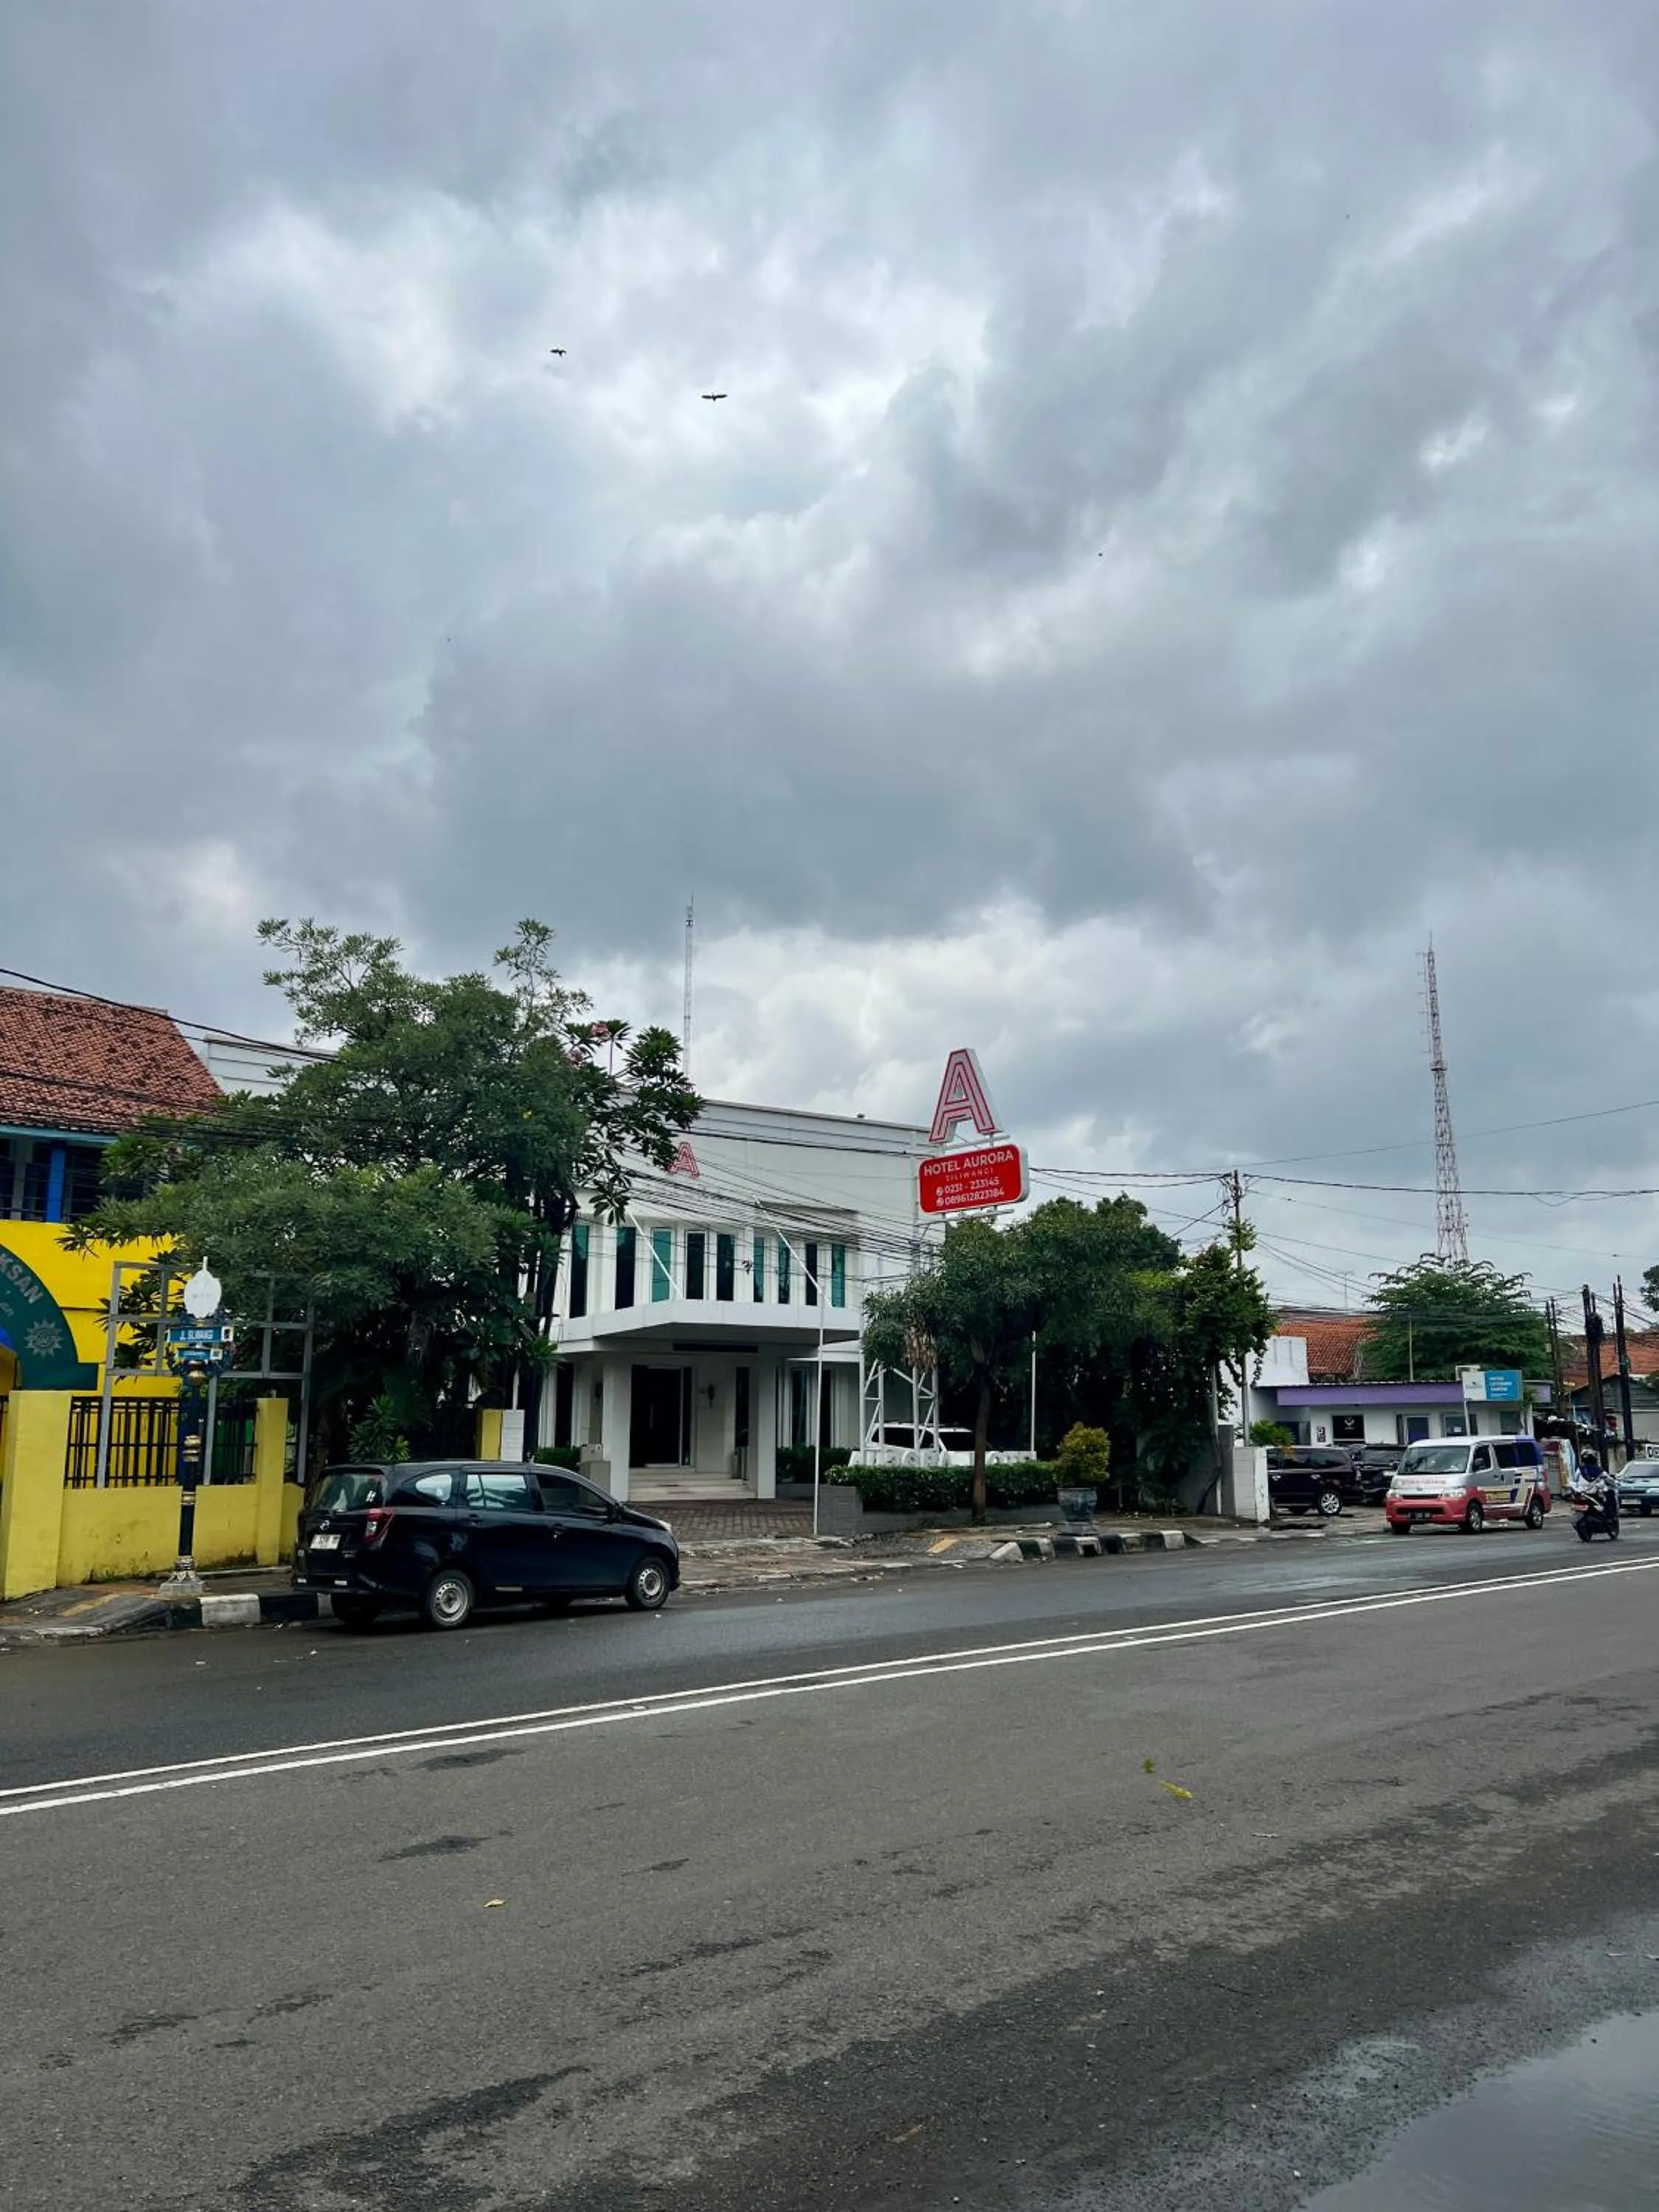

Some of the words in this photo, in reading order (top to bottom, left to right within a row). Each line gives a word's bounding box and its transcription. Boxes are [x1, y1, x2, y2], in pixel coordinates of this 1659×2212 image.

[929, 1048, 998, 1142] A
[667, 1141, 700, 1177] A
[924, 1161, 961, 1176] HOTEL
[963, 1150, 1014, 1168] AURORA
[945, 1183, 963, 1194] 0231
